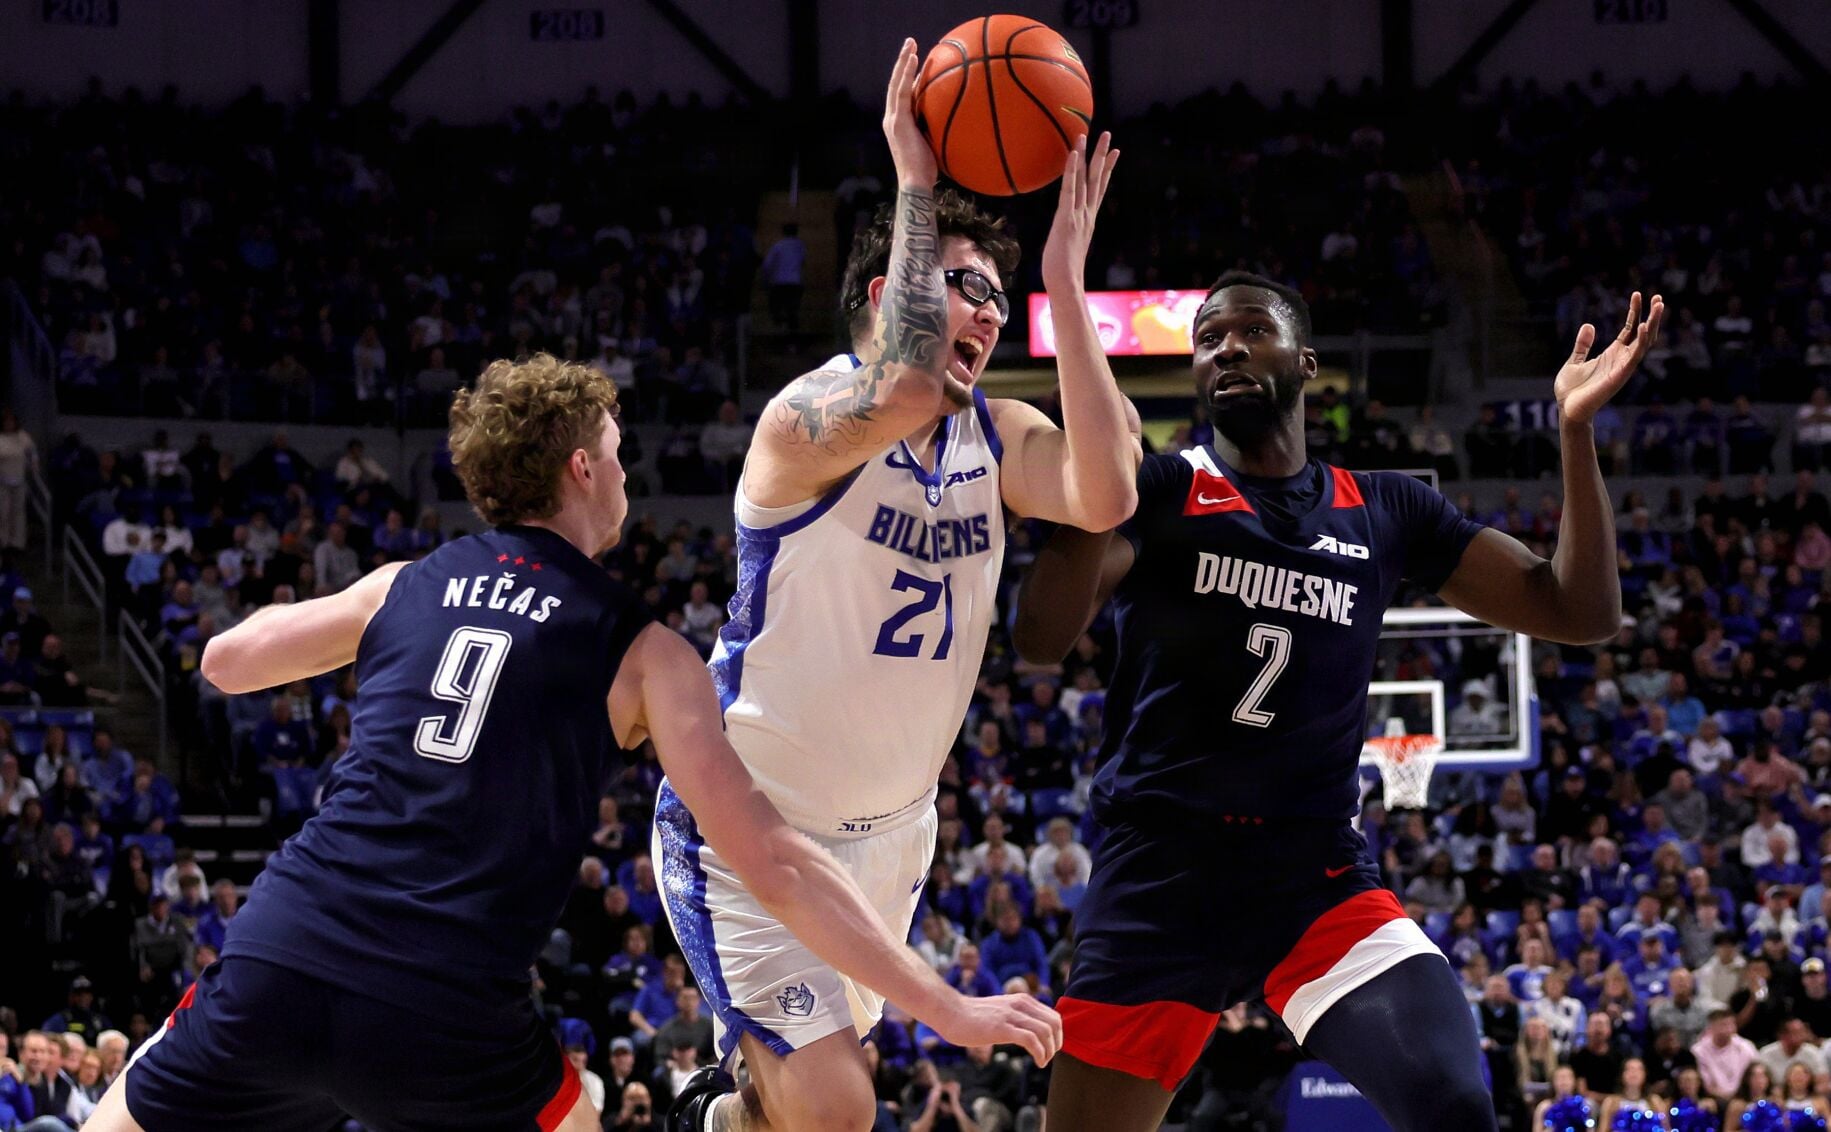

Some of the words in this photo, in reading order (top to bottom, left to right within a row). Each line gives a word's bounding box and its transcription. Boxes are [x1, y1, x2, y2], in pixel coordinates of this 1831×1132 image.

[944, 466, 987, 489] A10
[864, 502, 991, 563] BILLIENS
[1308, 534, 1370, 560] A10
[442, 571, 562, 623] NEČAS
[872, 568, 954, 660] 21
[1193, 551, 1359, 627] DUQUESNE
[413, 625, 513, 764] 9
[1231, 622, 1293, 728] 2
[1301, 1076, 1364, 1098] Edwar
